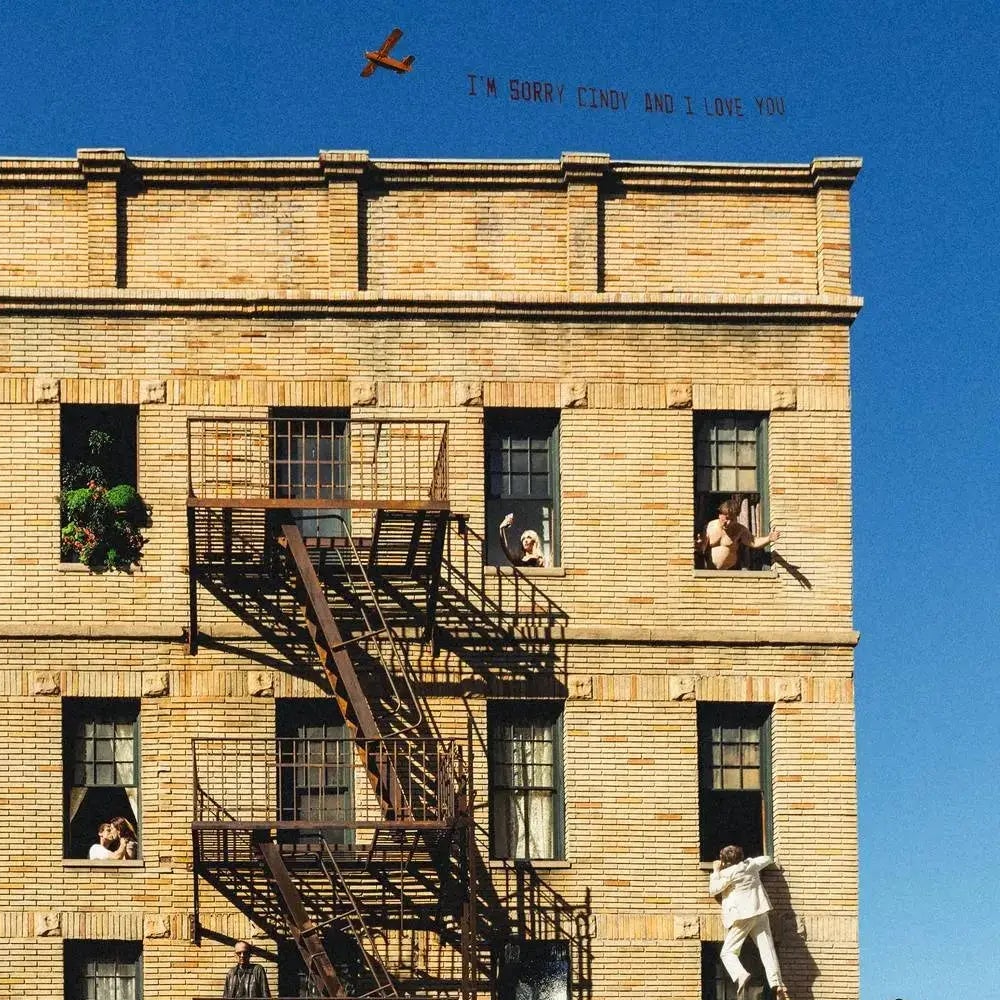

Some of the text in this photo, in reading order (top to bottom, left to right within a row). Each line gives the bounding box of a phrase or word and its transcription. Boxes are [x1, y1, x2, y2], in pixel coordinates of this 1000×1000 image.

[467, 74, 786, 117] I'M SORRY CINDY AND I LOVE YOU
